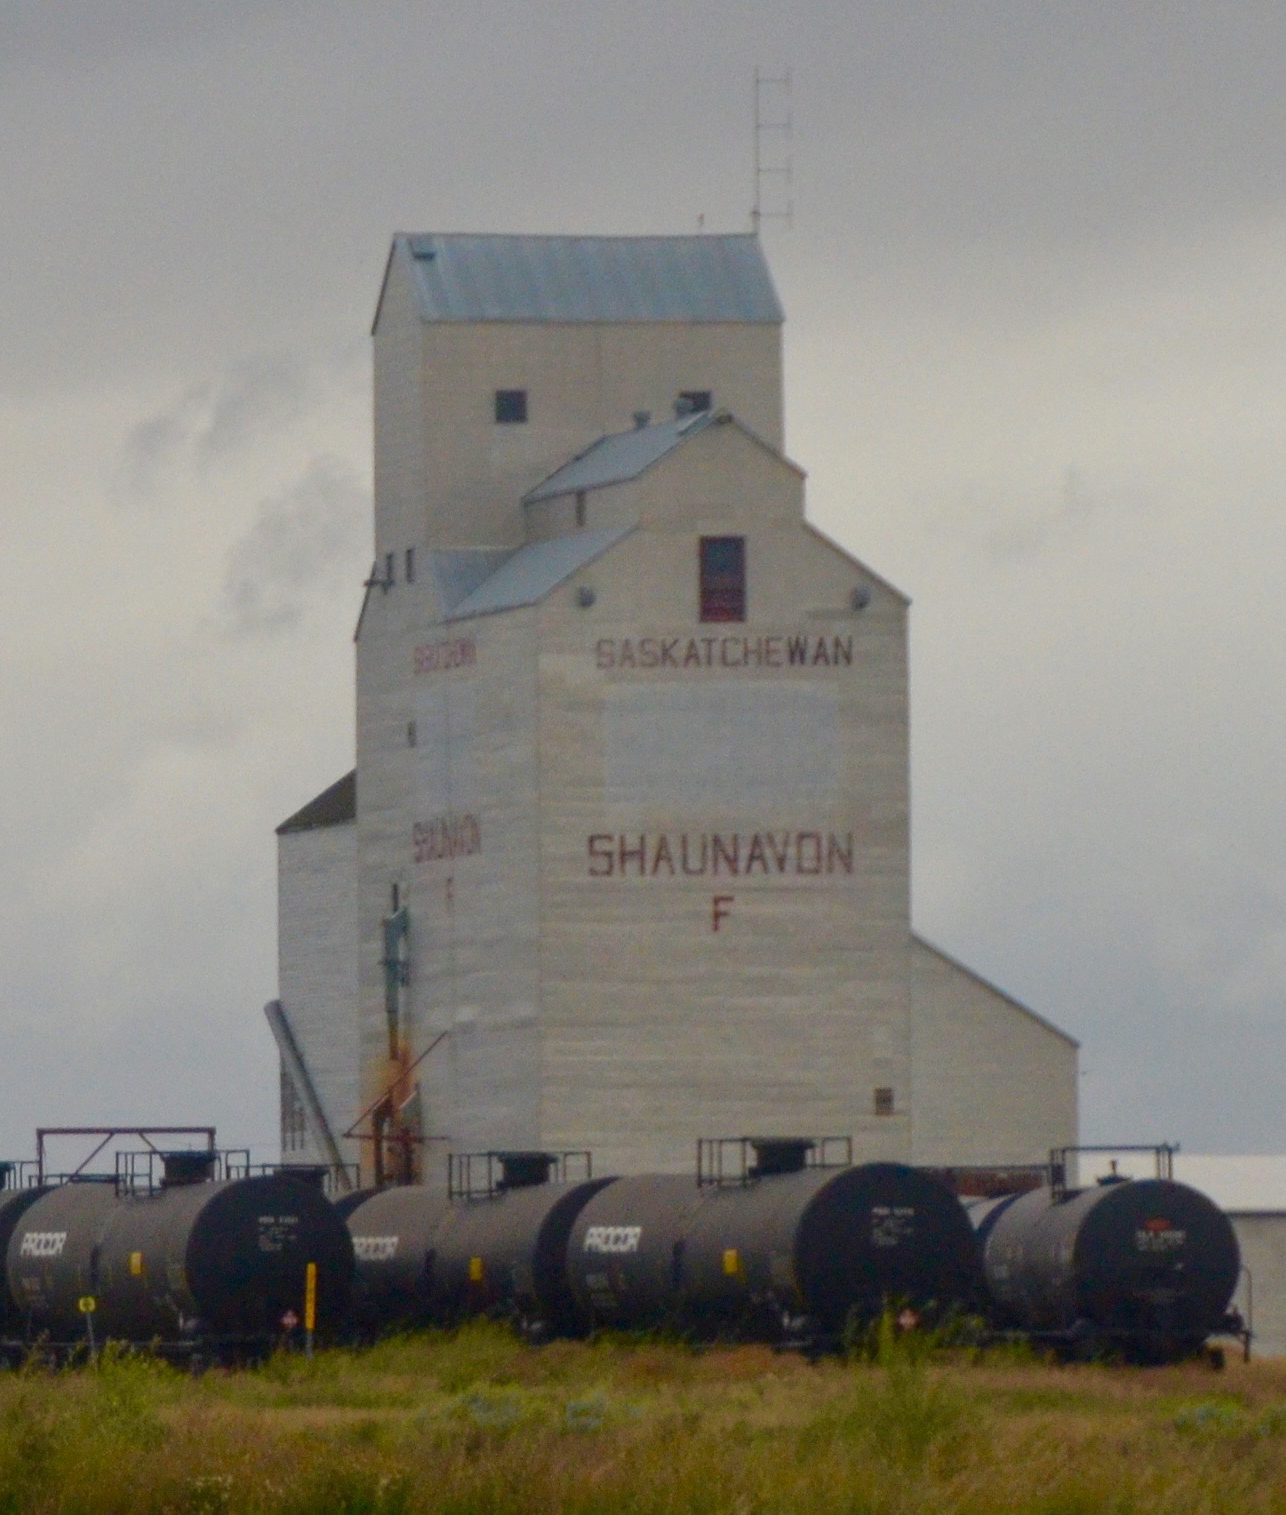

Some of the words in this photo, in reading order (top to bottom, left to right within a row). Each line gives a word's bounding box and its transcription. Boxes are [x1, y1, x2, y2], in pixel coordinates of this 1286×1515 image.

[594, 634, 854, 669] SASKATCHEWAN
[587, 831, 854, 878] SHAUNAVON
[711, 895, 734, 933] F
[20, 1231, 67, 1257] PROCOR
[583, 1225, 642, 1253] PROCOR
